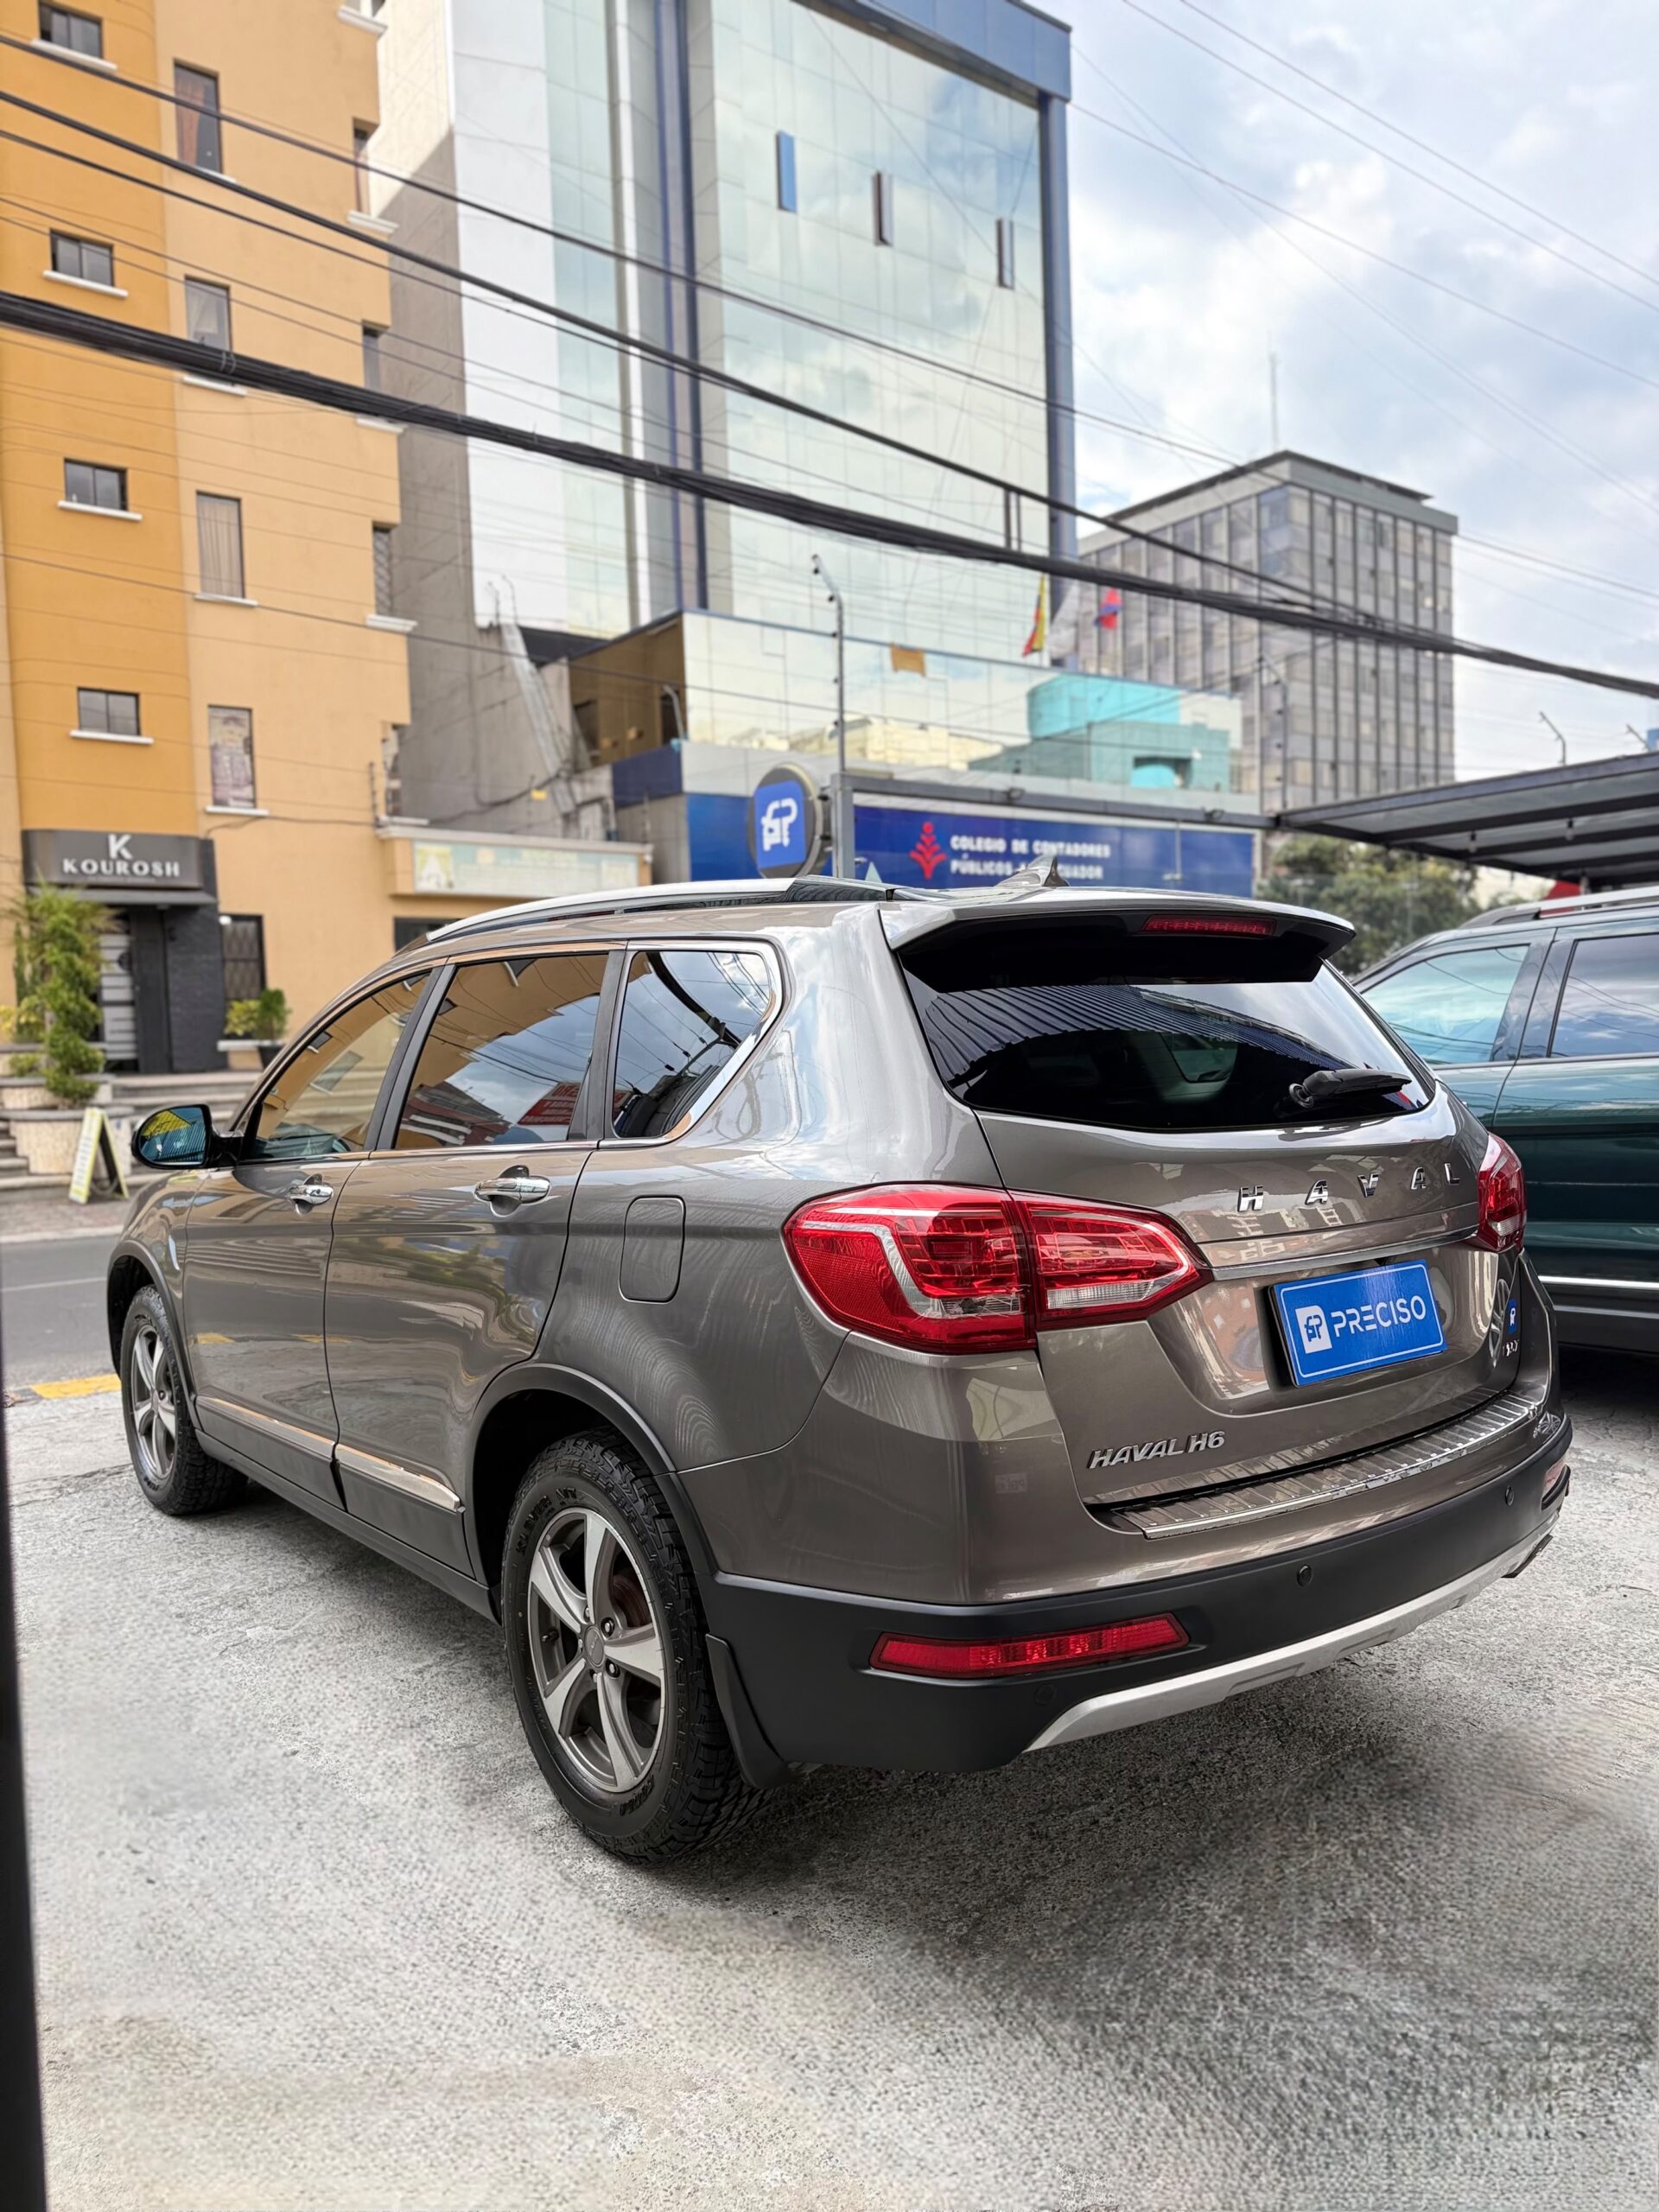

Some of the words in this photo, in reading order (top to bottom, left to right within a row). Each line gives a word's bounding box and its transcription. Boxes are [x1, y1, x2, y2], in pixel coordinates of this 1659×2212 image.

[108, 833, 133, 860] K
[950, 835, 1007, 853] COLEGIO
[1011, 839, 1028, 855] DE
[1032, 840, 1110, 858] CONTADORES
[62, 858, 180, 877] KOUROSH
[1237, 1162, 1460, 1211] HAVAL
[1331, 1294, 1427, 1338] PRECISO
[1087, 1439, 1184, 1470] HAVAL
[1186, 1430, 1225, 1454] H6
